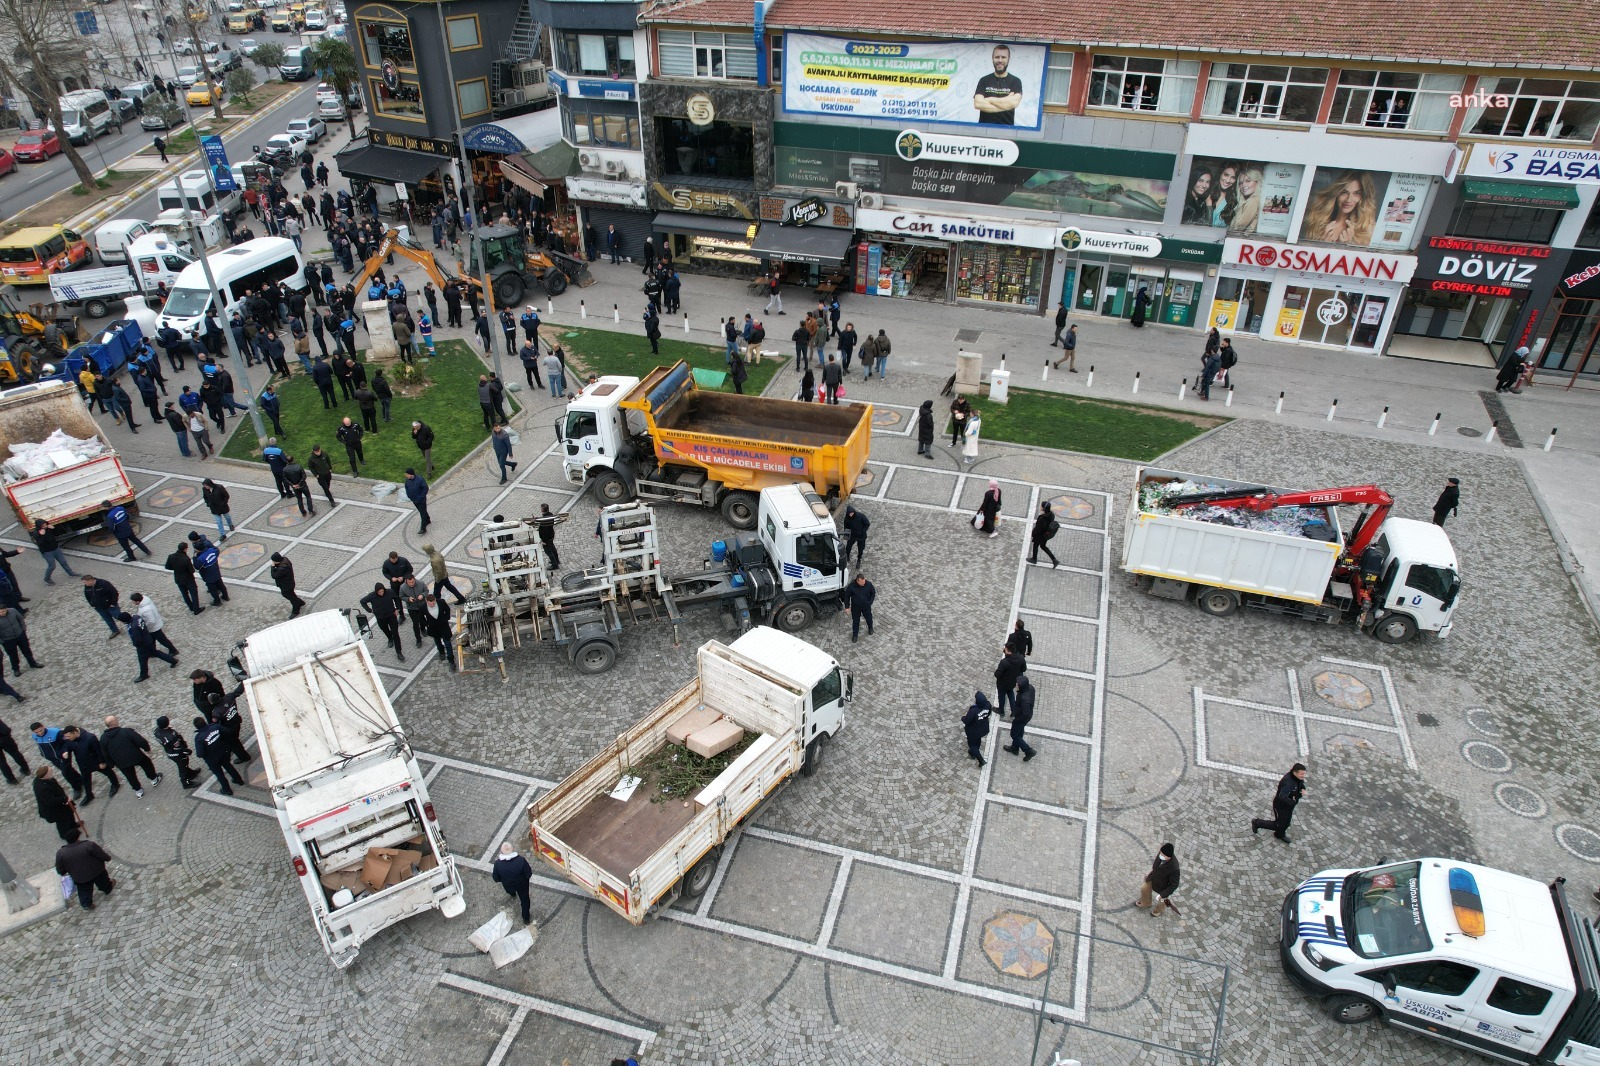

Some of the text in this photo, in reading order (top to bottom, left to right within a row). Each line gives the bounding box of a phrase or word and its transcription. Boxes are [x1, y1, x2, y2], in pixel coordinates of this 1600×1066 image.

[852, 45, 902, 55] 2022-2023
[873, 58, 885, 67] VE
[885, 59, 935, 71] MEZUNLAR
[936, 60, 956, 72] İÇİN
[806, 68, 948, 87] AVANTAJLI KAYITLARIMIZ BAŞLAMIŞTIR
[800, 85, 841, 95] HOCALARA
[850, 87, 878, 97] GELDİK
[821, 102, 854, 111] ÜSKÜDAR
[888, 100, 906, 108] (216)
[1532, 149, 1600, 161] ALİ OSMA
[912, 166, 997, 186] Başka bir deneyim,
[1525, 160, 1600, 180] BAŞA
[911, 179, 956, 193] başka sen
[892, 215, 1015, 241] Can ŞARKÜTERİ
[379, 238, 392, 257] CASE
[1238, 244, 1399, 280] ROSSMANN
[1438, 254, 1538, 283] DÖVİZ
[1564, 263, 1600, 289] Keb
[1432, 280, 1474, 292] ÇEYREK
[1477, 285, 1511, 296] ALTIN
[1517, 309, 1539, 350] EXCHAN
[693, 444, 769, 461] KIŞ ÇALIŞMALARI
[698, 454, 711, 463] İLE
[713, 455, 761, 469] MÜCADELE
[763, 461, 787, 473] EKİBİ
[1312, 493, 1340, 502] FASSI
[1408, 877, 1421, 926] ÜSKÜDAR ZABITA
[1402, 1003, 1445, 1022] ZABITA
[1405, 999, 1448, 1018] ÜSKÜDAR
